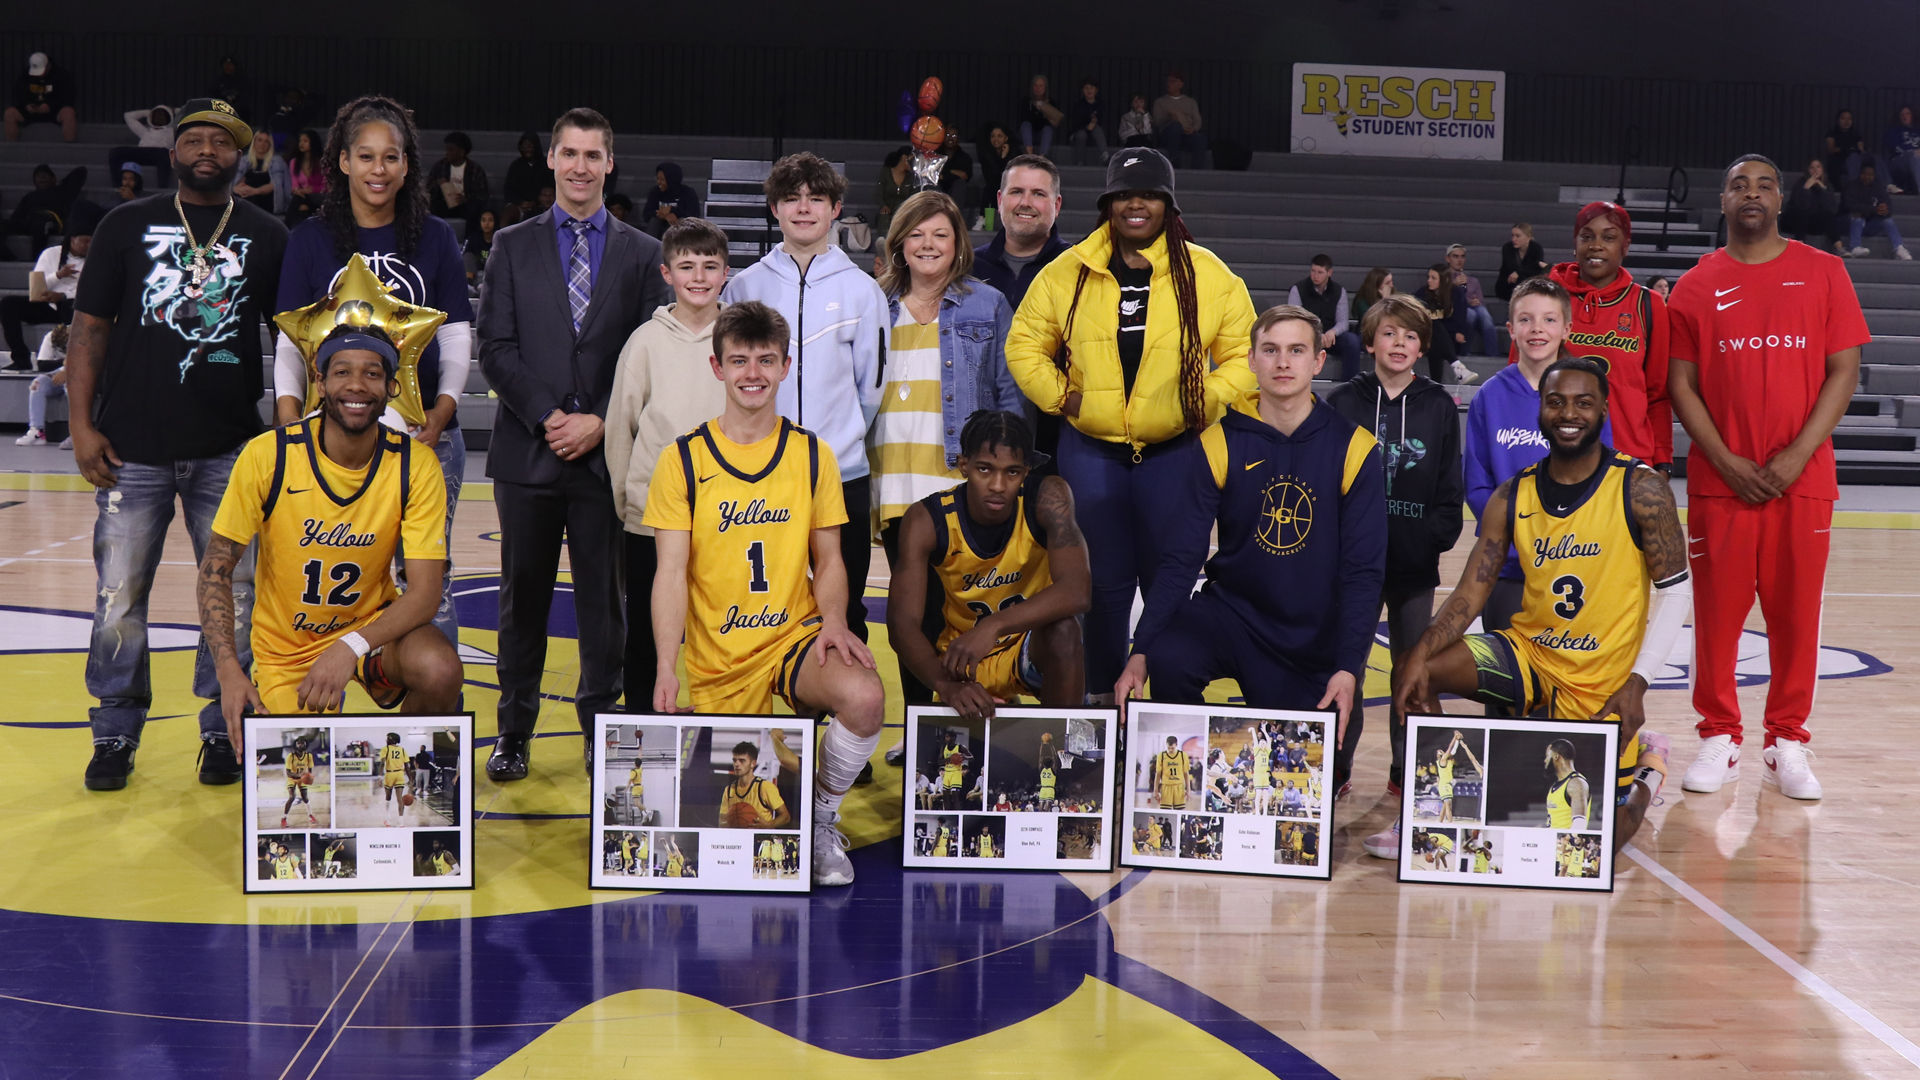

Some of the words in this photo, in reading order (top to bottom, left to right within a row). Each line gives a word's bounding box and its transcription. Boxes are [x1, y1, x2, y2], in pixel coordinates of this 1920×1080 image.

[1302, 73, 1496, 122] RESCH
[1352, 118, 1425, 137] STUDENT
[1427, 122, 1496, 139] SECTION
[143, 225, 187, 304] デク
[1566, 329, 1640, 353] raceland
[1719, 334, 1807, 353] SWOOSH
[718, 498, 791, 533] Yellow
[1385, 499, 1425, 519] RFECT
[299, 518, 377, 548] Yellow
[1533, 532, 1602, 568] Yellow
[300, 557, 362, 607] 12
[745, 540, 770, 594] 1
[1550, 573, 1587, 622] 3
[391, 750, 400, 760] 12
[1169, 768, 1177, 776] 11
